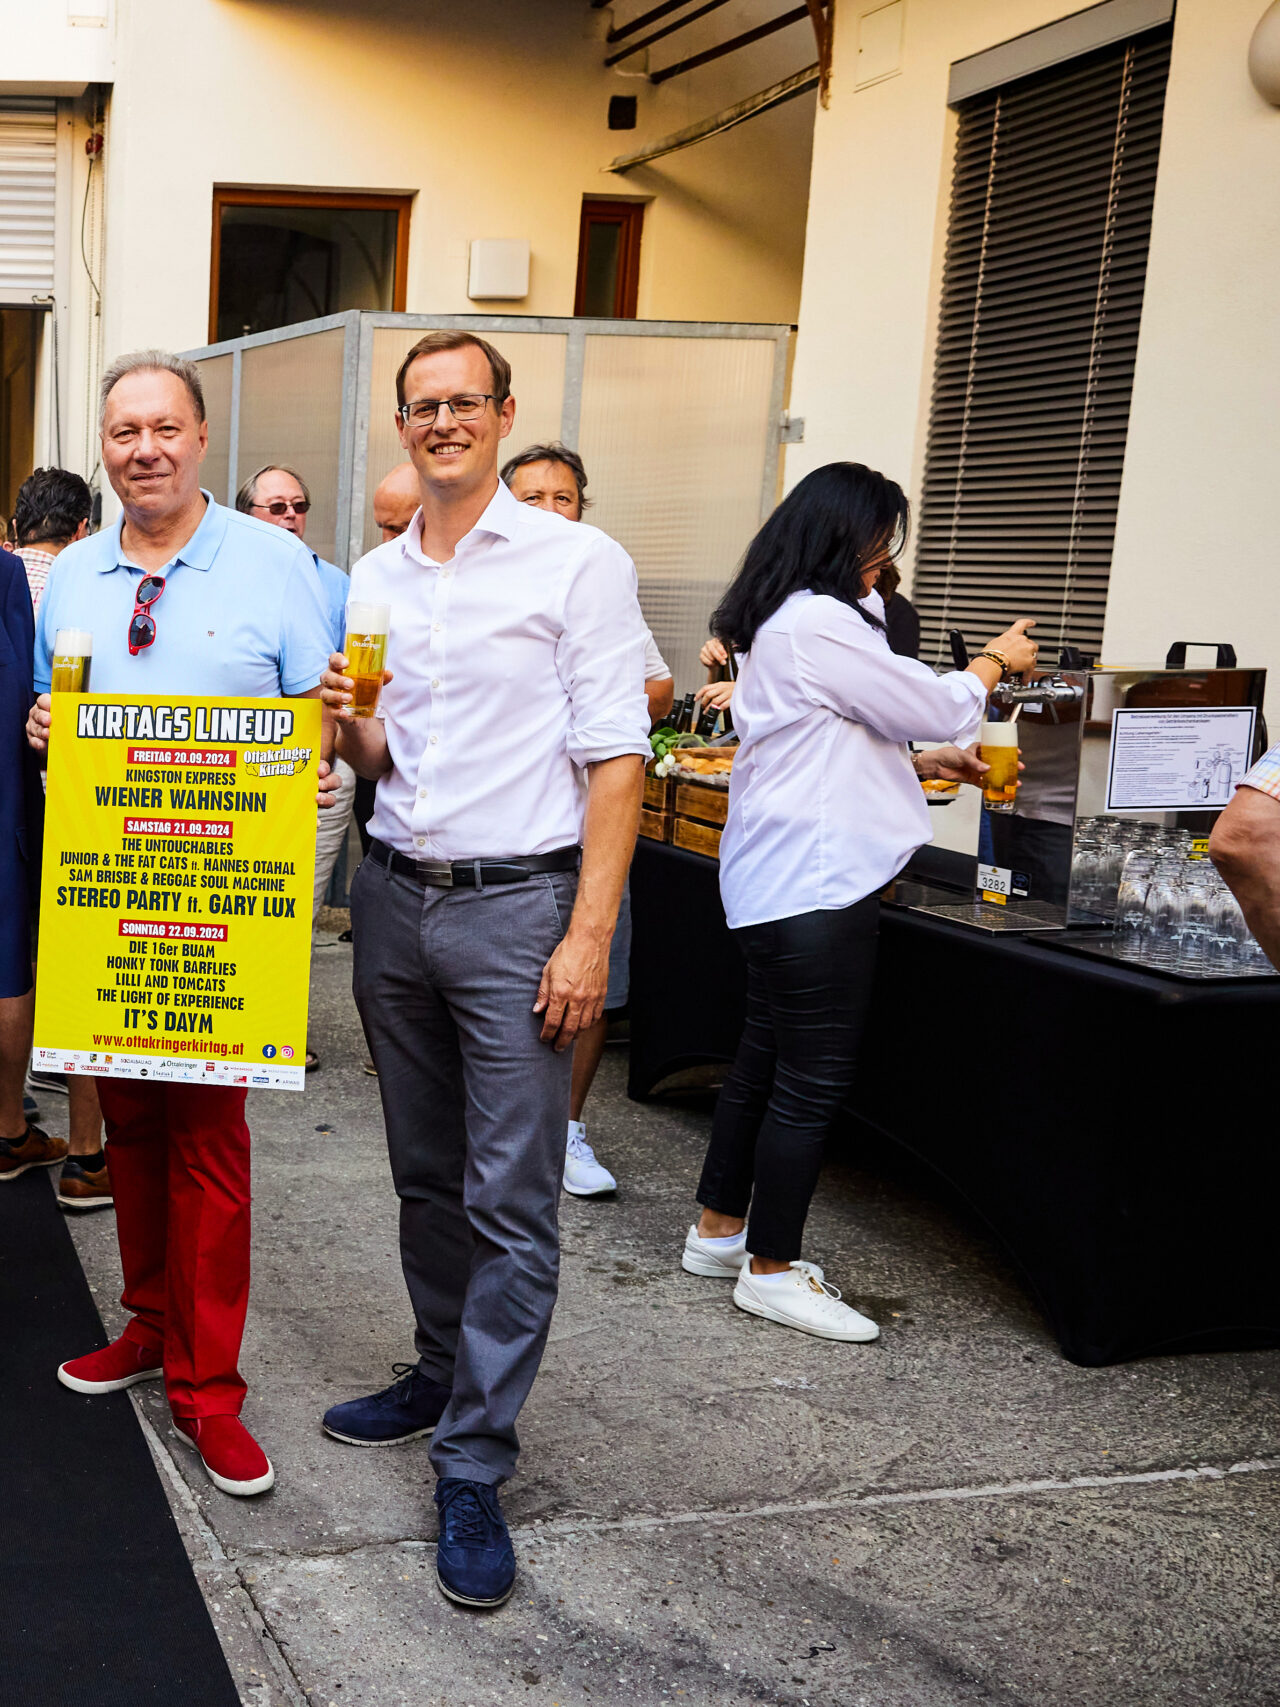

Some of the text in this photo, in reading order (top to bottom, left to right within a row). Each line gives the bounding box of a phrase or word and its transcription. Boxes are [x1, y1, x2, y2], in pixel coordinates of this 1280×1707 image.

[77, 704, 294, 744] KIRTAGS LINEUP
[133, 750, 230, 765] FREITAG 20.09.2024
[243, 747, 312, 764] Ottakringer
[126, 769, 236, 786] KINGSTON EXPRESS
[258, 760, 295, 778] Kirtag
[95, 786, 267, 812] WIENER WAHNSINN
[126, 820, 230, 836] SAMSTAG 21.09.2024
[122, 838, 234, 856] THE UNTOUCHABLES
[60, 852, 296, 876] JUNIOR & THE FAT CATS ft. HANNES OTAHAL
[69, 869, 285, 892] SAM BRISBE & REGGAE SOUL MACHINE
[982, 877, 1006, 892] 3282
[57, 886, 296, 918] STEREO PARTY ft. GARY LUX
[122, 922, 224, 940] SONNTAG 22.09.2024
[130, 941, 215, 958] DIE 16er BUAM
[106, 956, 236, 976] HONKY TONK BARFLIES
[116, 973, 226, 992] LILLI AND TOMCATS
[97, 988, 244, 1010] THE LIGHT OF EXPERIENCE
[164, 1011, 213, 1034] DAYM
[93, 1034, 244, 1056] www.ottakringerkirtag.at
[166, 1060, 198, 1070] Ottakringer
